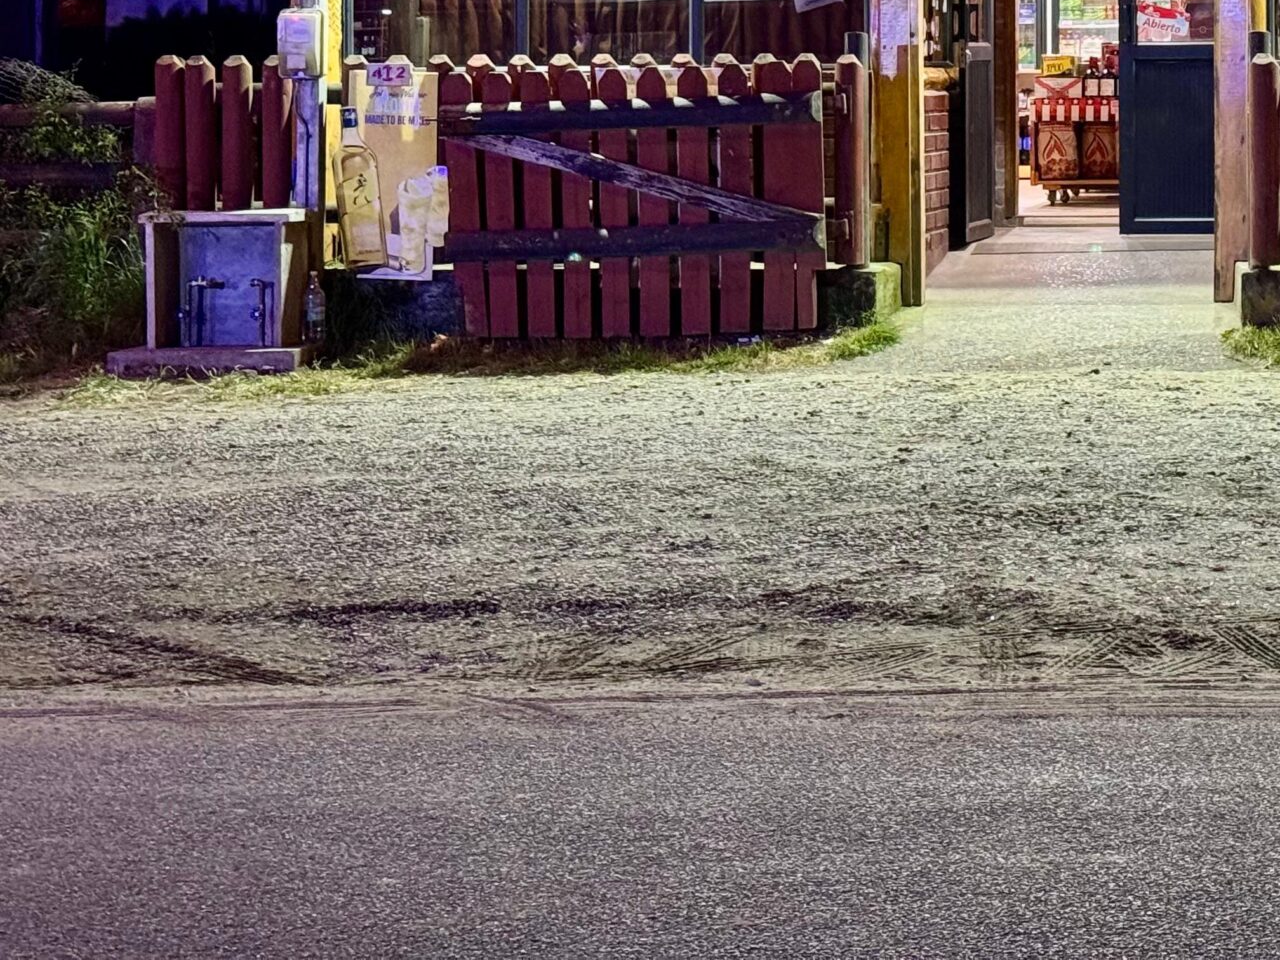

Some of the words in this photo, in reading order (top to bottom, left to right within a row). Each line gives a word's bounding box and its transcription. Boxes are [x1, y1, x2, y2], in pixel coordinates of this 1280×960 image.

[1142, 17, 1182, 34] Abierto
[386, 115, 396, 125] TO
[397, 115, 406, 126] BE
[408, 115, 431, 126] MED
